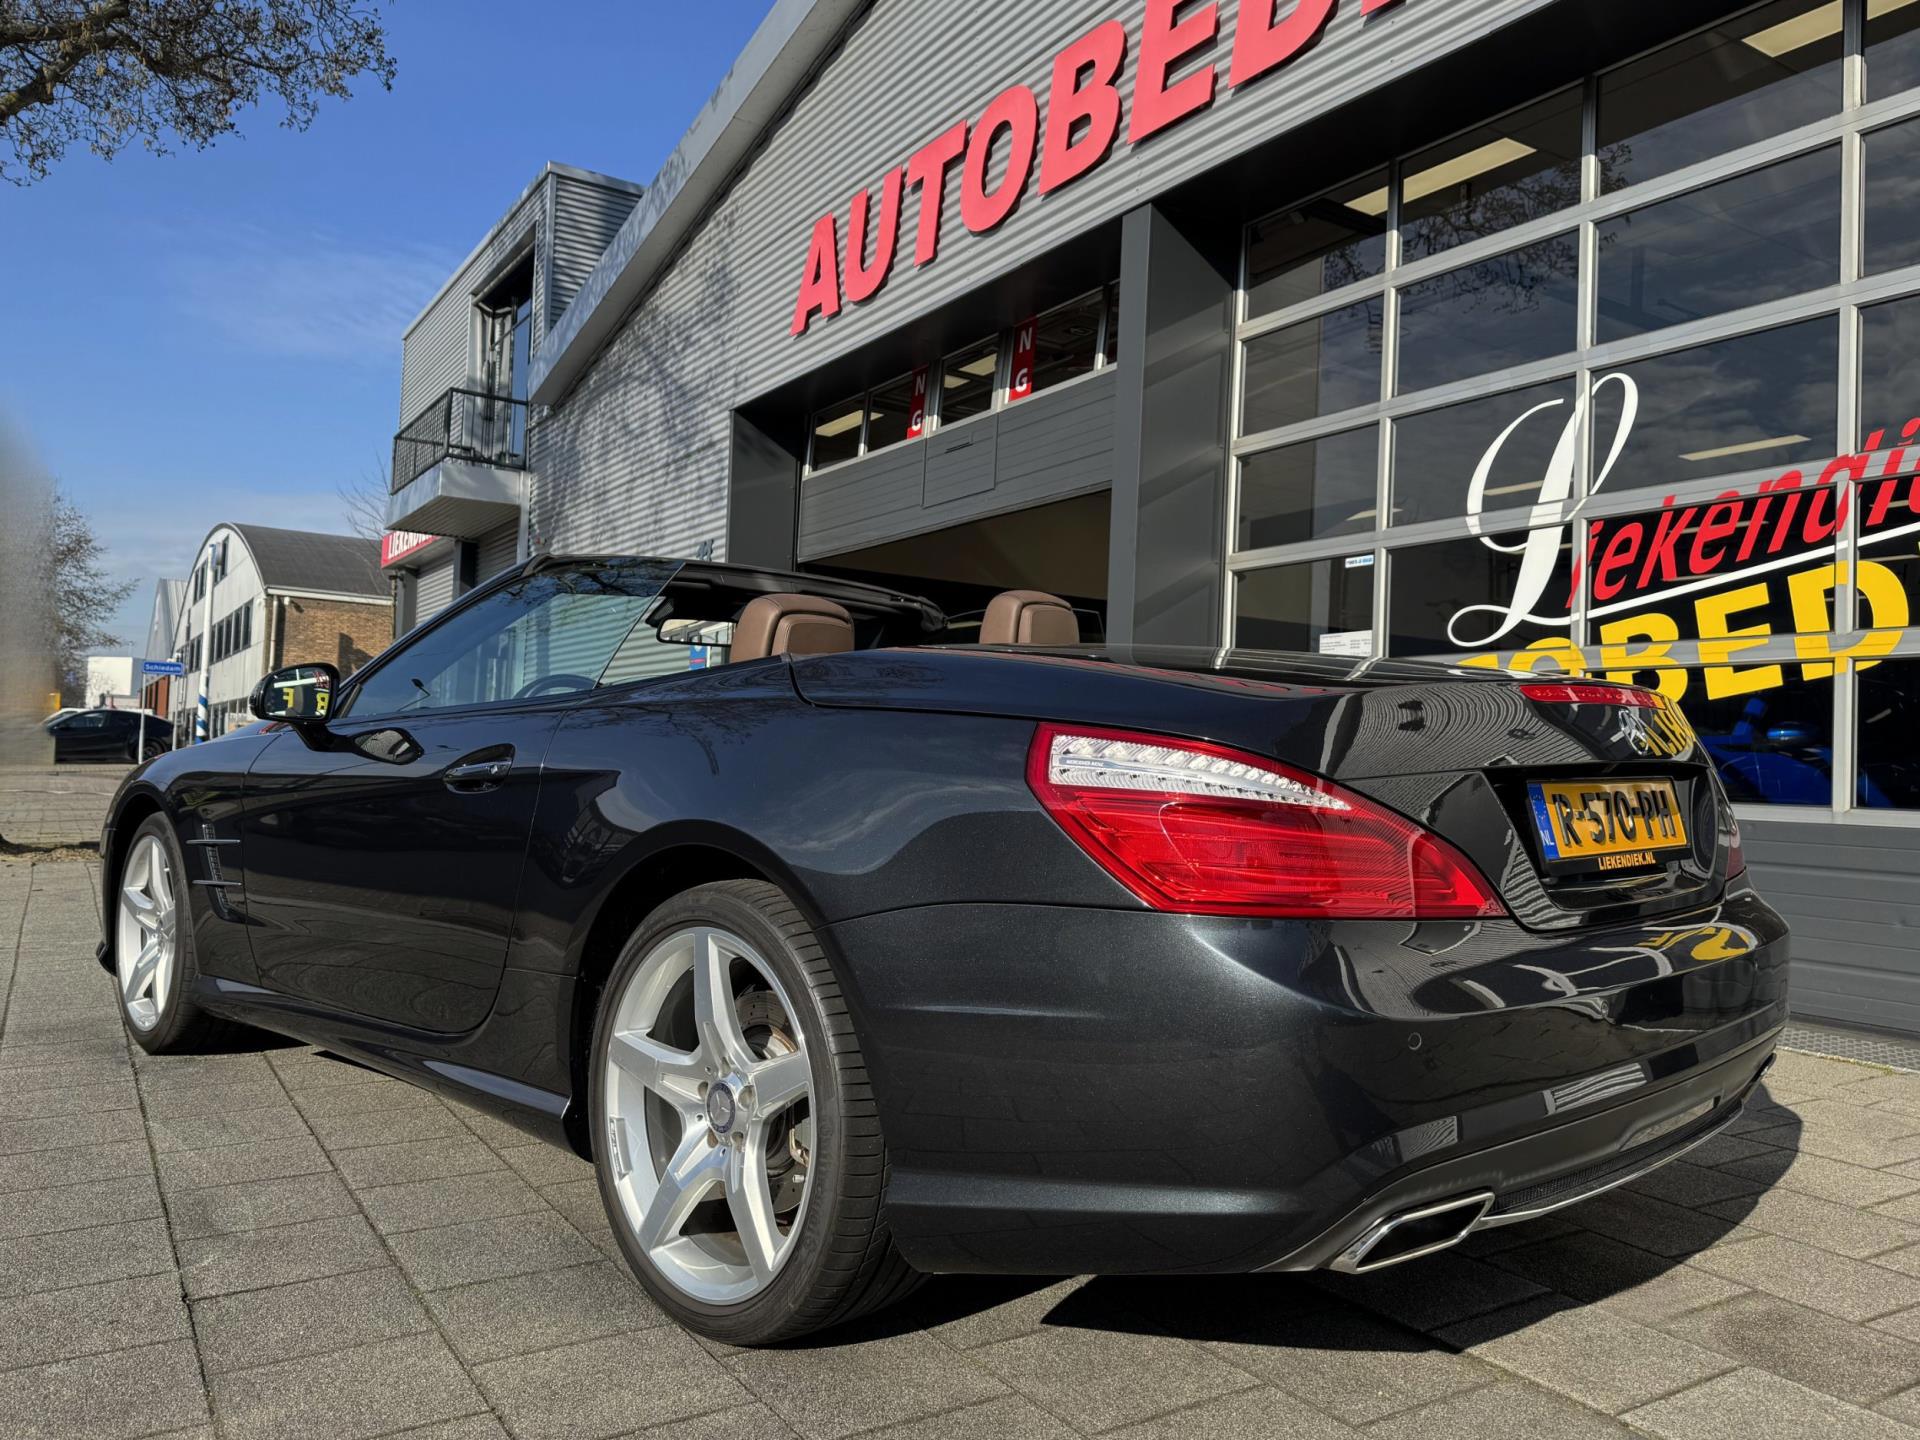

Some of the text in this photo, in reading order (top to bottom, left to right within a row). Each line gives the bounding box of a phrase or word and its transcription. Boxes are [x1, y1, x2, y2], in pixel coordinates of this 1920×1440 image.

[1447, 373, 1920, 647] Liekendi
[1540, 829, 1555, 846] NL
[1552, 791, 1676, 847] R-570-PH
[1598, 851, 1656, 871] LIEKENDIEK.NL
